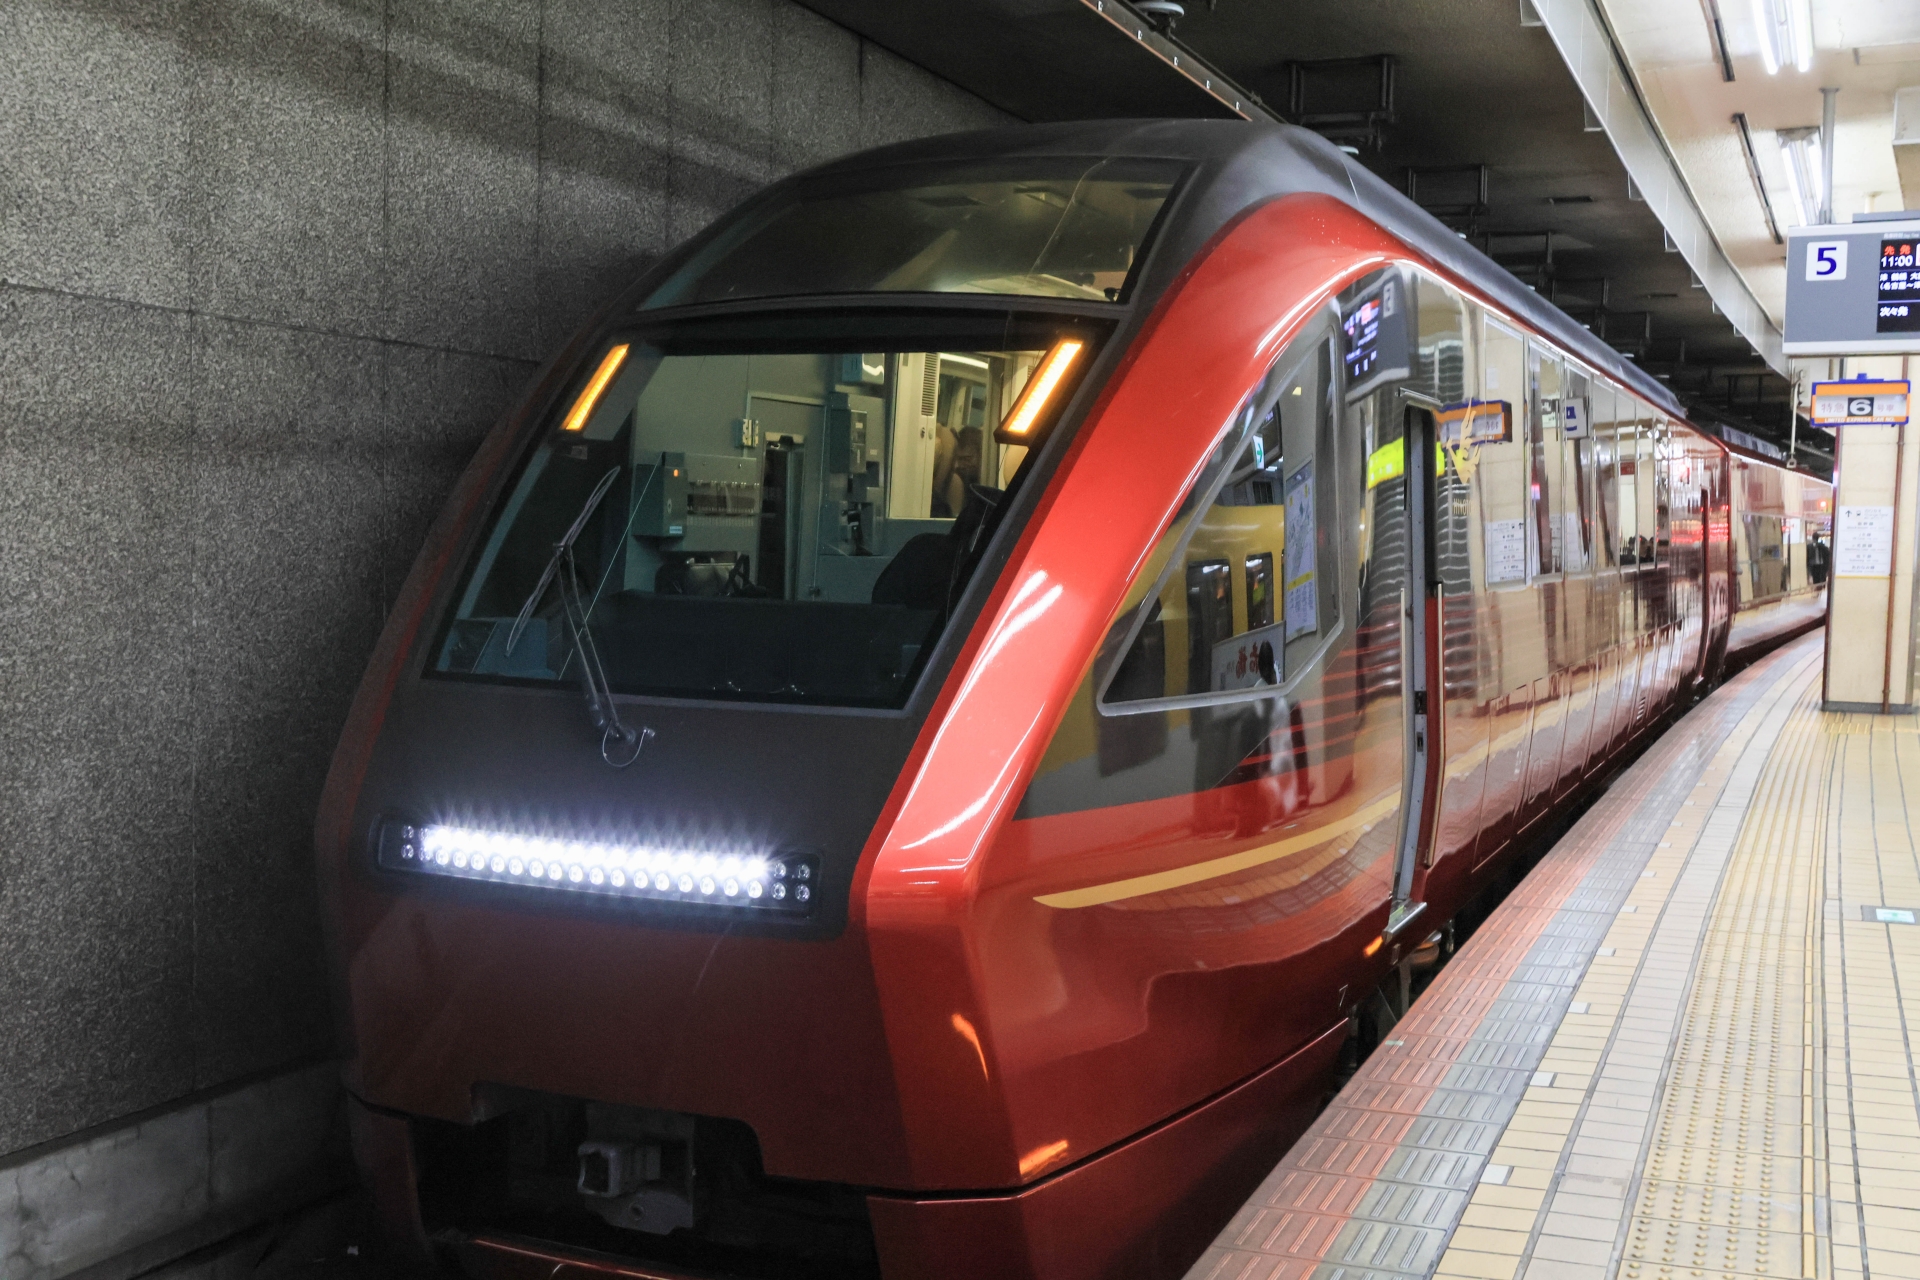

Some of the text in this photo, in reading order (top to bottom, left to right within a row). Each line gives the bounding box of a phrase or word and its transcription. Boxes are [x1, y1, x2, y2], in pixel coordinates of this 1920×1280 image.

[1816, 247, 1837, 275] 5
[1881, 255, 1913, 267] 11:00
[1821, 403, 1844, 413] 特急
[1849, 399, 1871, 415] 6
